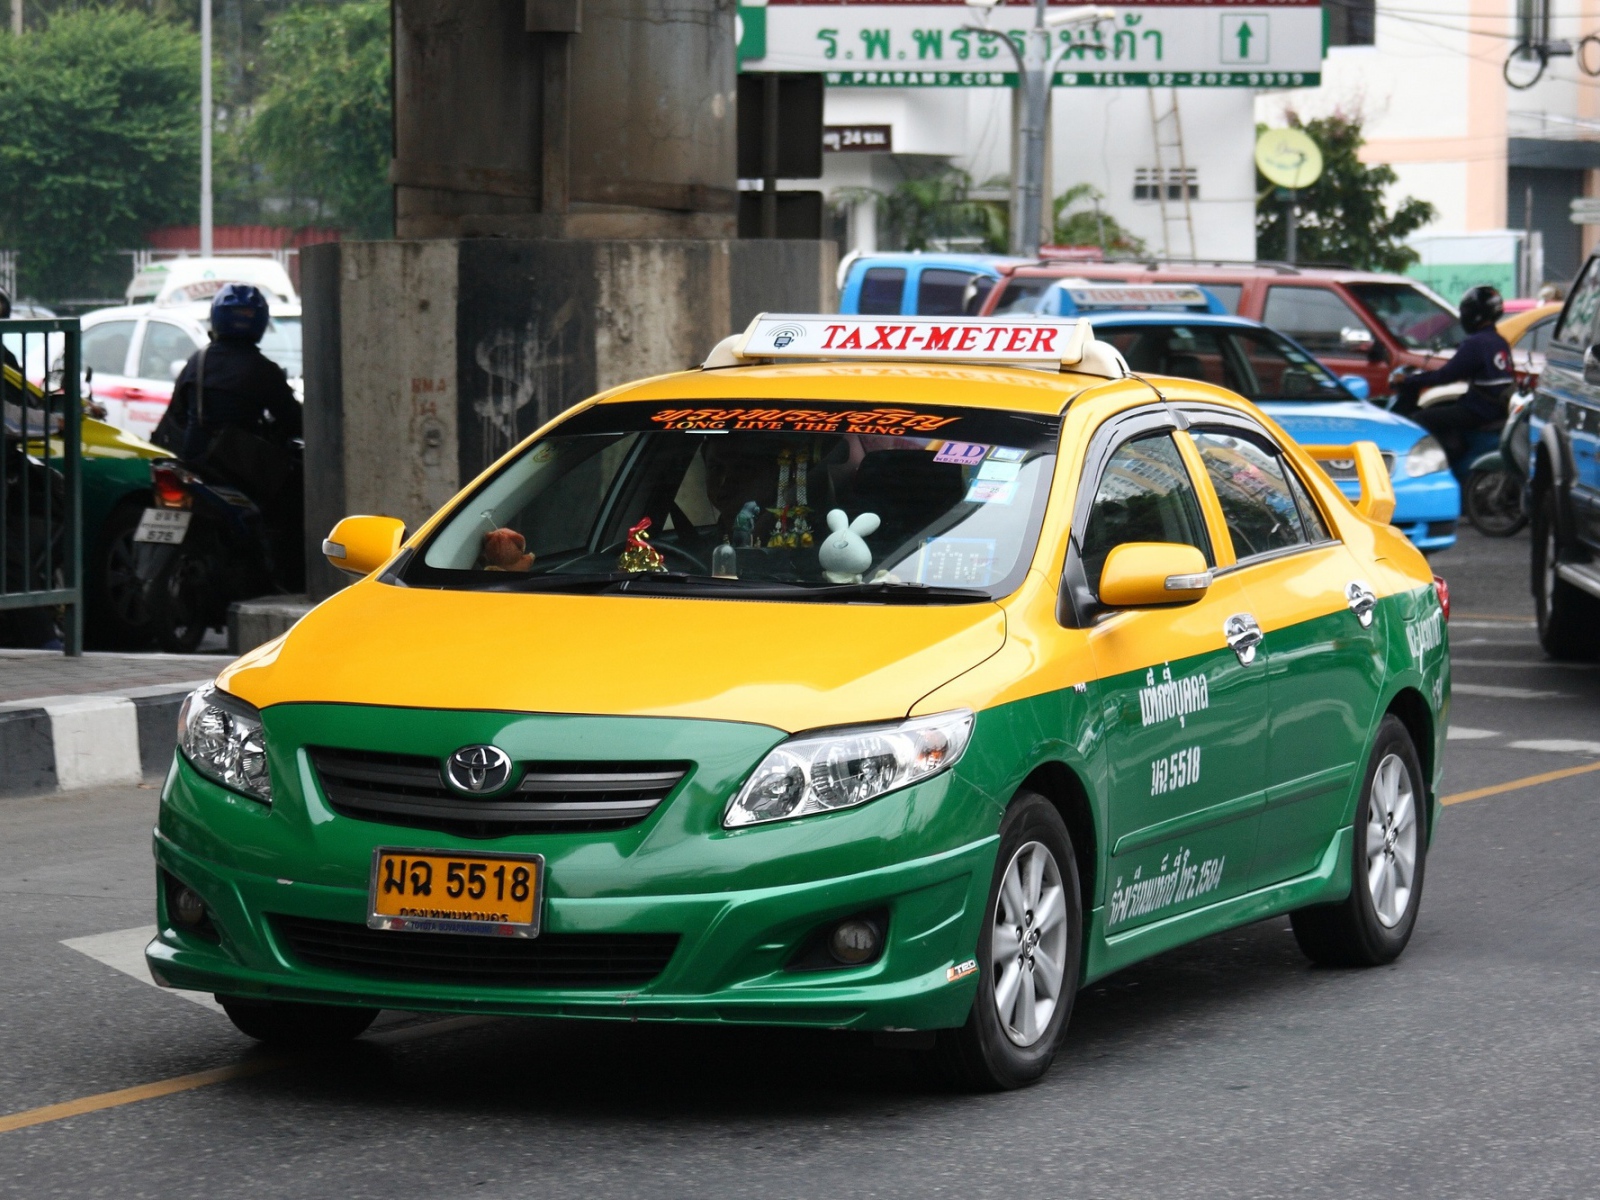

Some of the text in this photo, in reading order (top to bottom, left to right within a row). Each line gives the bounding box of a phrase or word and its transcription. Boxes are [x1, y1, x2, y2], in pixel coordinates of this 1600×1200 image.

[1093, 72, 1304, 86] TEL. 02-202-9999
[821, 324, 1059, 353] TAXI-METER
[662, 421, 906, 435] LONG LIVE THE KING
[1138, 660, 1209, 729] แท็กซี่บุคคล
[384, 858, 531, 903] มฉ 5518
[399, 906, 510, 923] กรงเทพมหานคร
[409, 921, 437, 931] TOYOTA
